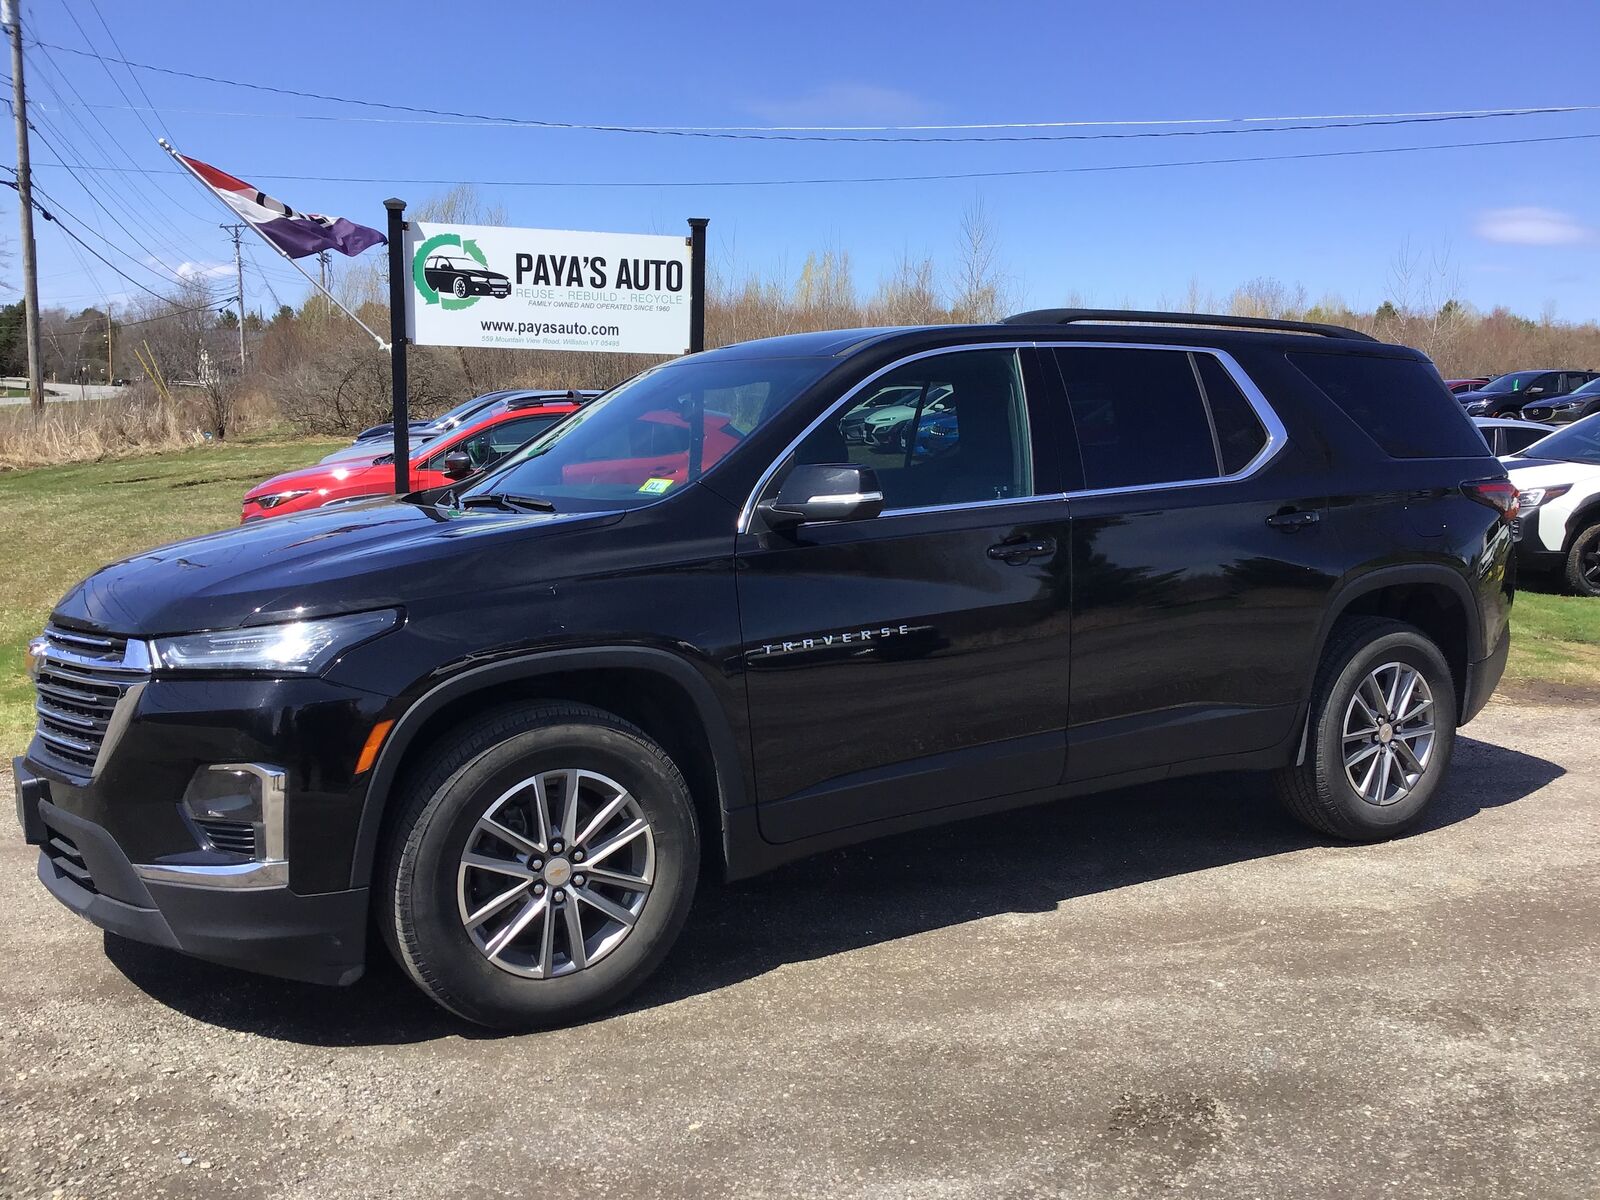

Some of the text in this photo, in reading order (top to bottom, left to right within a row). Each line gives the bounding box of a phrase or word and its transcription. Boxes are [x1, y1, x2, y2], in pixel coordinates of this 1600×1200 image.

[516, 253, 683, 292] PAYA'S AUTO
[516, 288, 555, 299] REUSE
[568, 290, 617, 302] REBUILD
[630, 293, 682, 304] RECYCLE
[528, 299, 552, 307] FAMILY
[553, 301, 579, 309] OWNED
[596, 303, 632, 311] OPERATED
[480, 321, 619, 336] www.payasauto.com
[495, 335, 524, 343] Mountain
[526, 336, 541, 344] View
[762, 625, 908, 655] TRAVERSE
